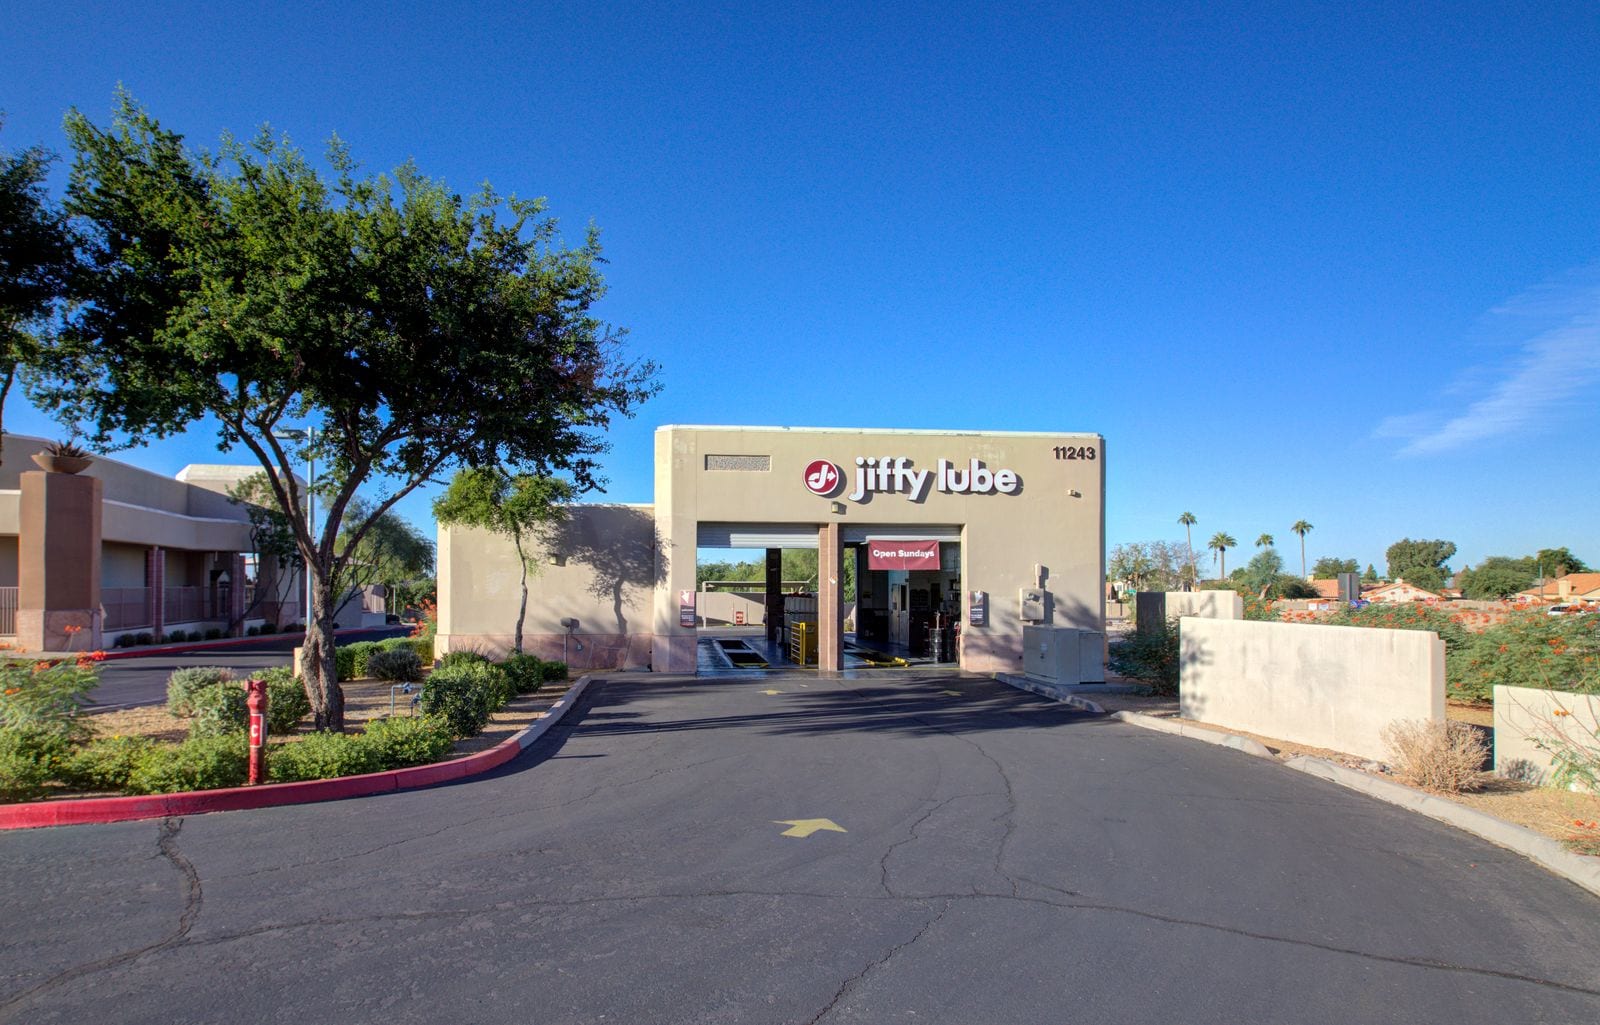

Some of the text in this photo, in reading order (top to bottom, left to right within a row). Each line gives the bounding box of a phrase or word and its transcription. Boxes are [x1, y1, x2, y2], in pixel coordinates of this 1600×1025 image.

[1053, 446, 1096, 460] 11243
[848, 456, 1017, 501] jiffy lube
[873, 549, 935, 559] Open Sundays
